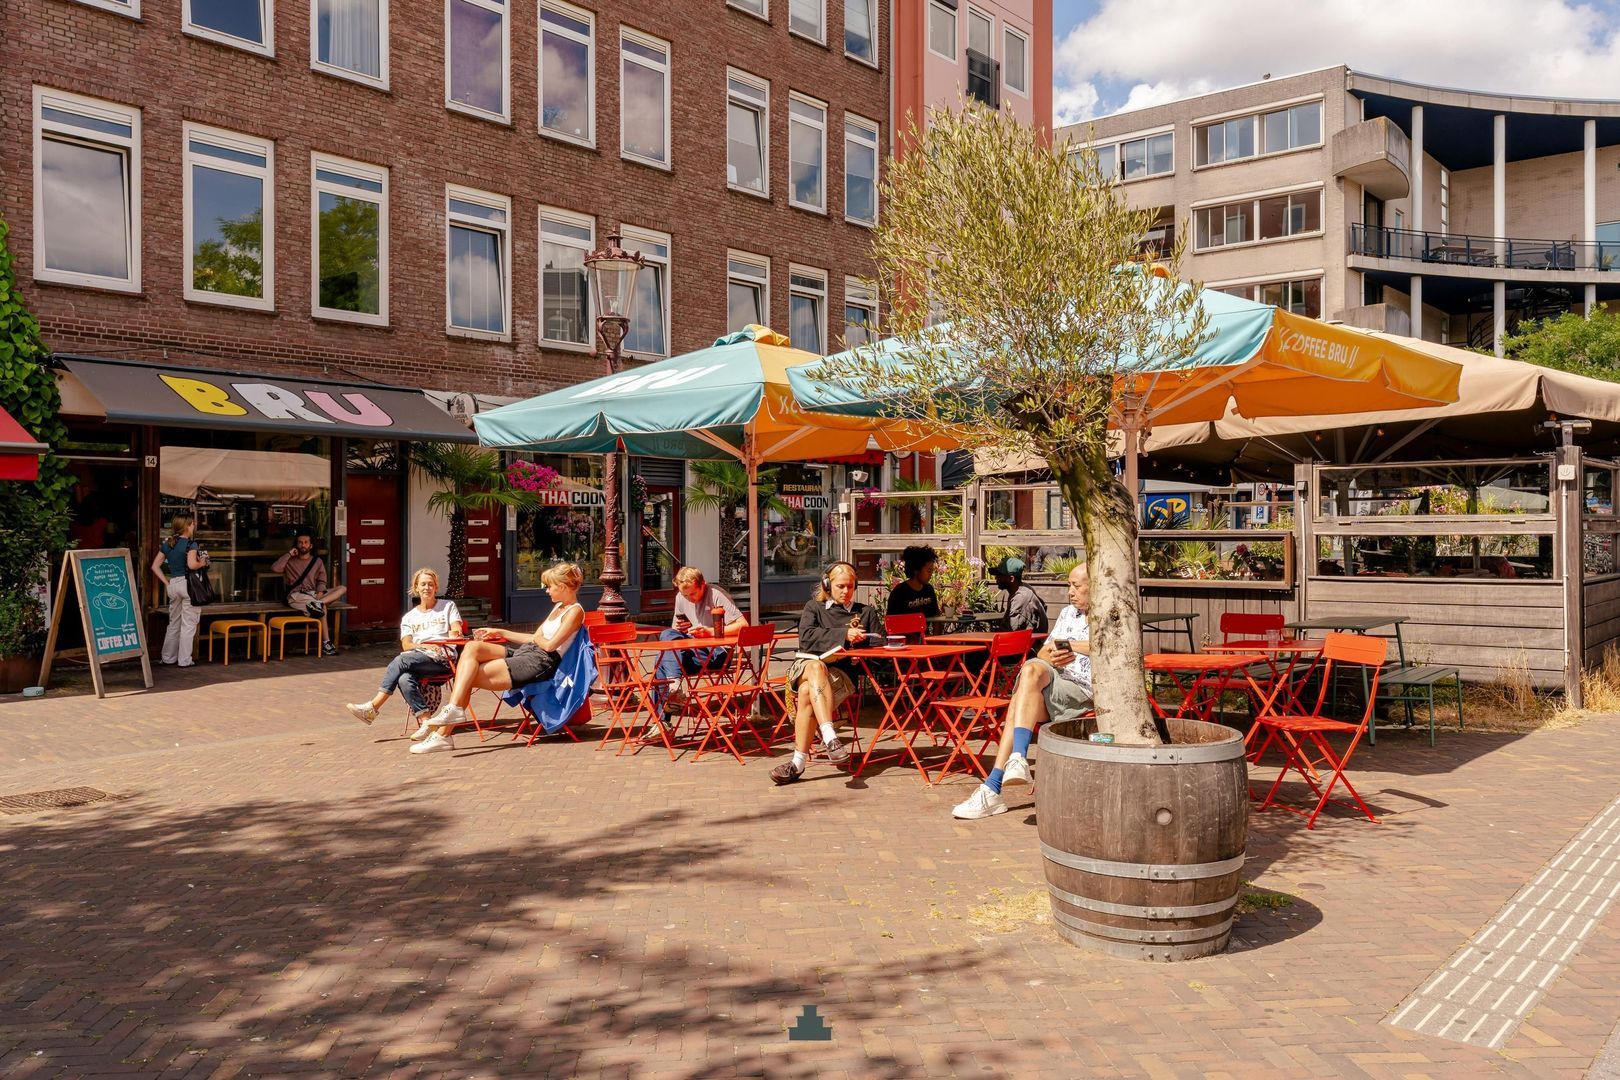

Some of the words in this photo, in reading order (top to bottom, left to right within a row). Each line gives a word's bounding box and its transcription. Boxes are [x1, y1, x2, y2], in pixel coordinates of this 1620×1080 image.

[1283, 333, 1328, 359] COFFEE
[1328, 341, 1349, 364] BRU
[568, 363, 728, 399] BRU
[157, 374, 393, 426] BRU
[146, 456, 156, 467] 14
